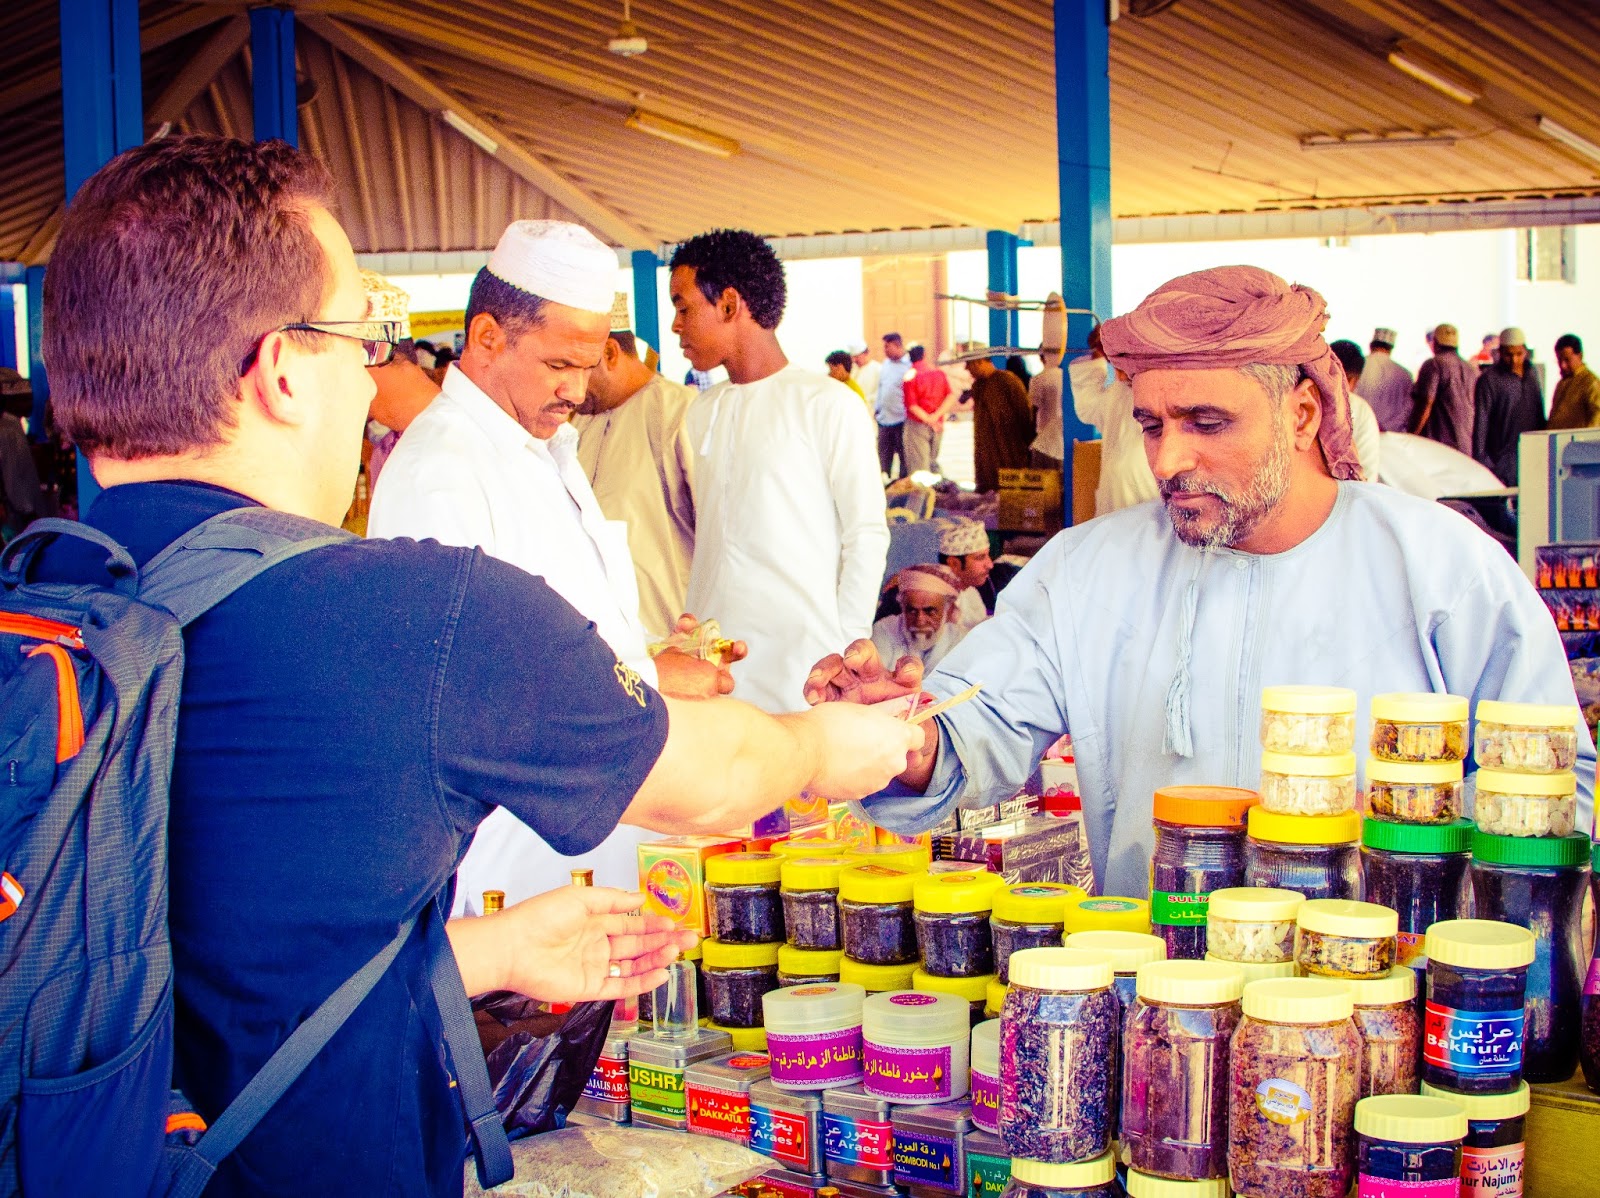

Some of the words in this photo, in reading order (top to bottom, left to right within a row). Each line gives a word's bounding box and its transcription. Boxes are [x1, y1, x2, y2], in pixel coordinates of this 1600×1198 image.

[1427, 1032, 1502, 1055] Bakhur
[902, 1066, 929, 1084] بخور
[700, 1108, 744, 1125] DAKKATUL
[760, 1119, 793, 1136] بخور
[754, 1129, 793, 1146] Araes
[843, 1128, 880, 1145] بخور
[838, 1139, 880, 1155] Araes
[895, 1153, 929, 1168] COMBODI
[1482, 1174, 1516, 1189] Najum
